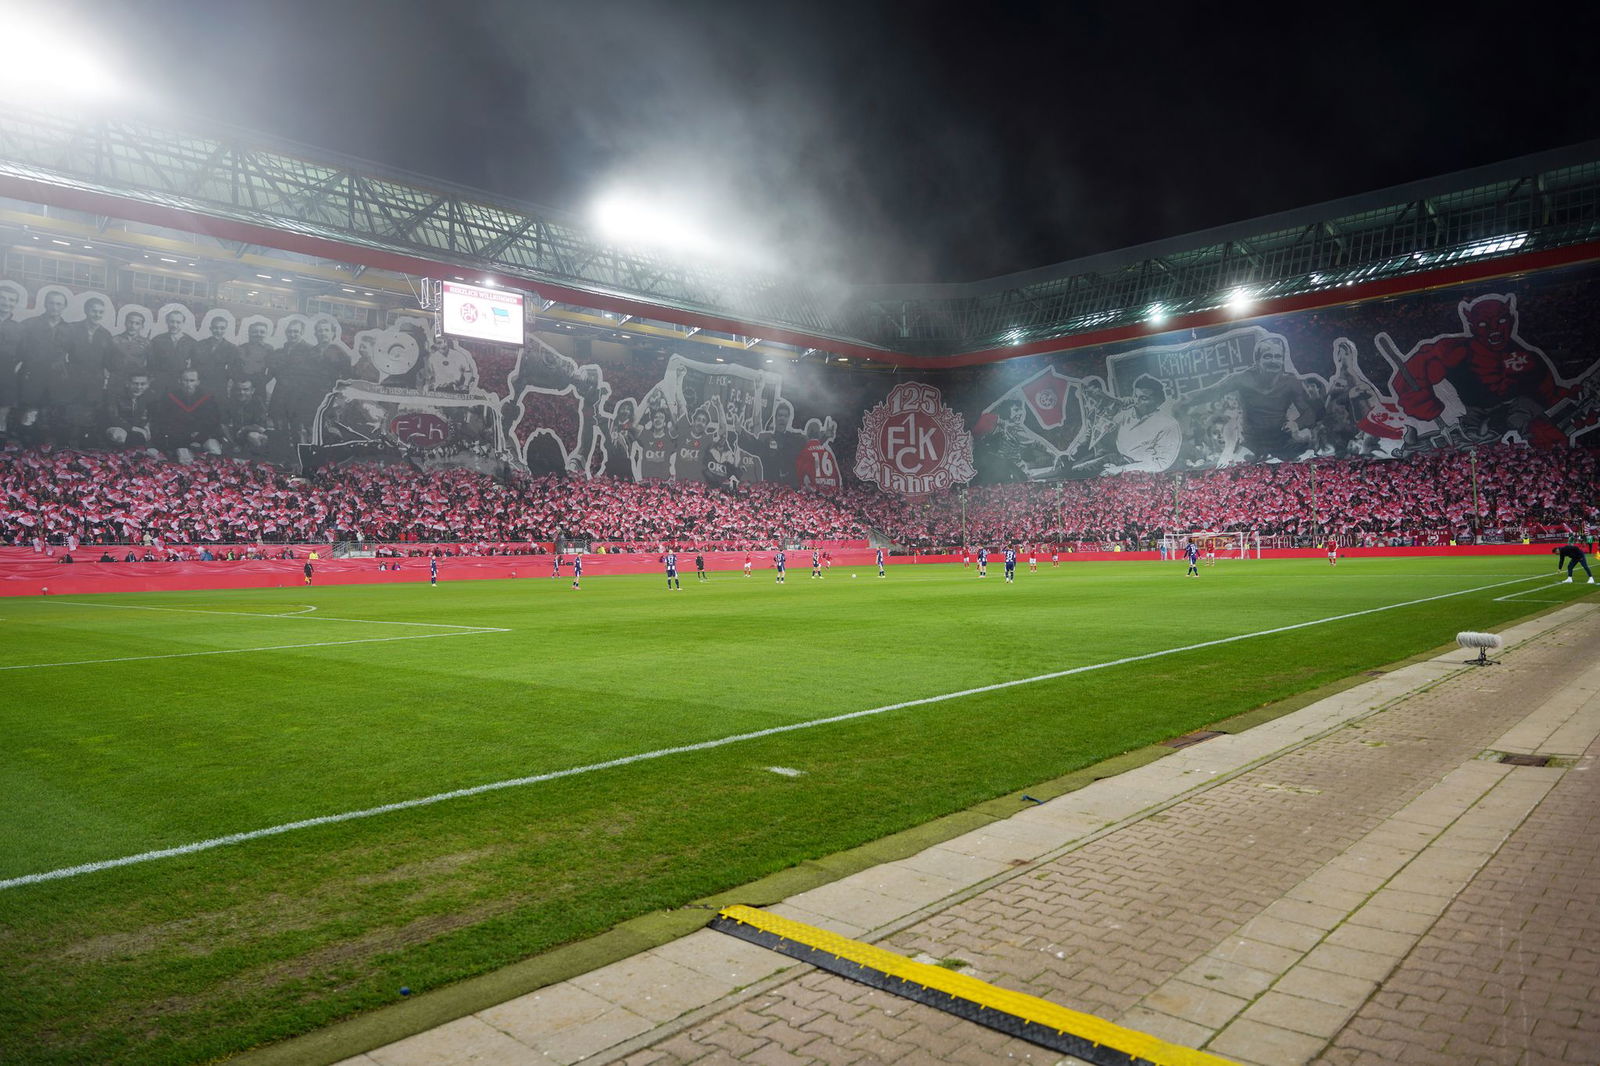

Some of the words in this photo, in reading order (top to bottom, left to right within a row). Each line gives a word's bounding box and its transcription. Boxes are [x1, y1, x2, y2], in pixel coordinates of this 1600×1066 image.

[1158, 338, 1242, 377] KÄMPFEN
[891, 387, 937, 415] 125
[645, 449, 665, 459] OKI
[680, 447, 700, 459] OKI
[811, 451, 833, 477] 16
[882, 465, 947, 493] Jahre
